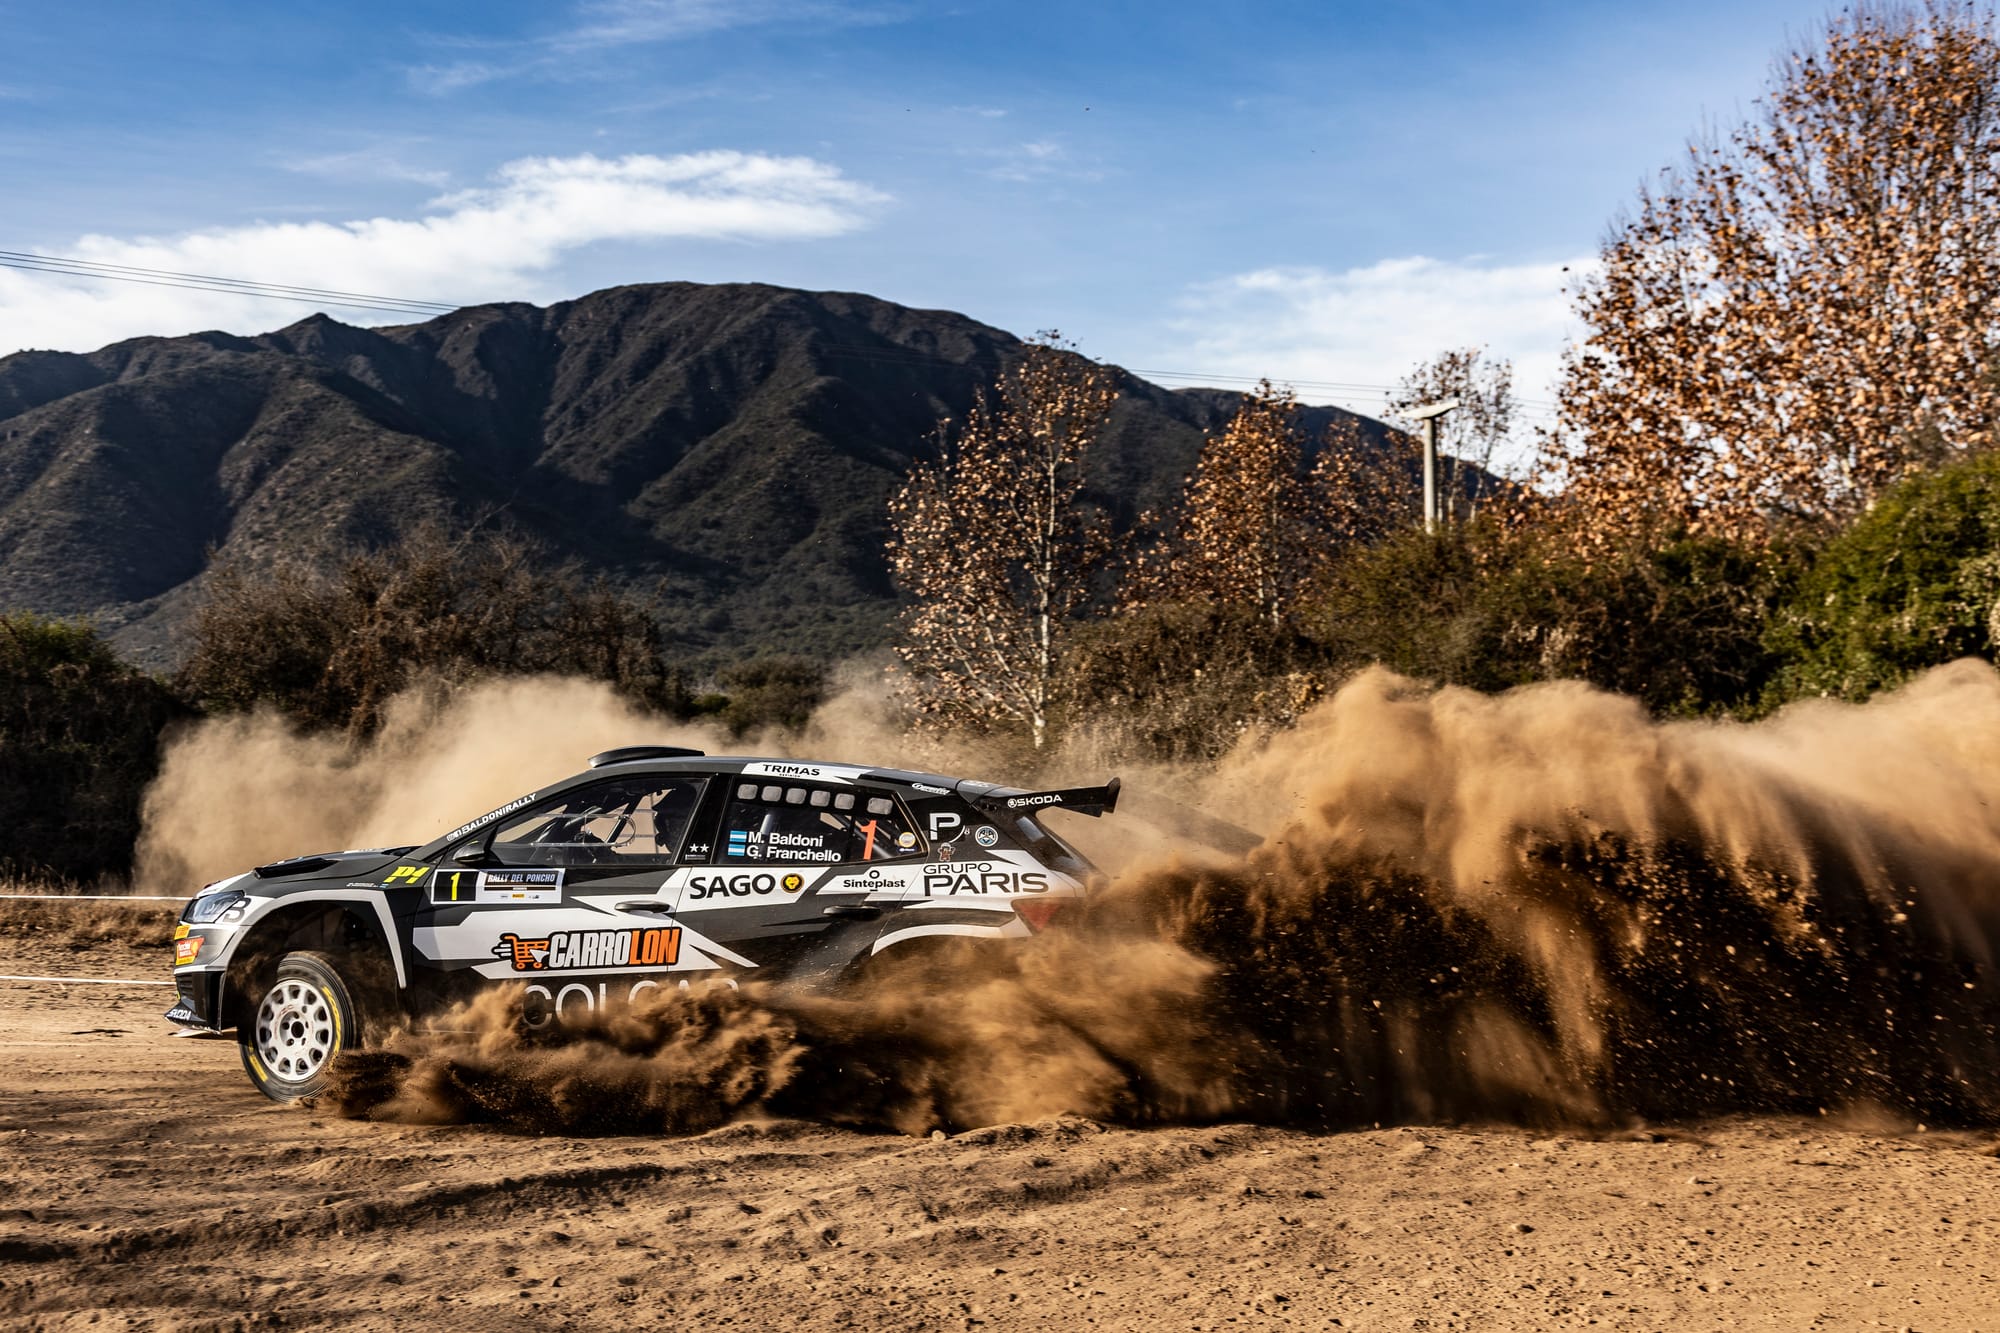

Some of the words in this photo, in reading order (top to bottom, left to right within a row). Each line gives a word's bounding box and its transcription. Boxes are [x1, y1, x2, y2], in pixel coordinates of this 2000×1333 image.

[762, 764, 820, 776] TRIMAS
[1017, 794, 1063, 807] SKODA
[747, 831, 765, 844] M.
[769, 832, 824, 848] Baldoni
[861, 820, 877, 861] 1
[746, 845, 762, 859] G.
[766, 847, 842, 863] Franchello
[923, 862, 993, 875] GRUPO
[487, 874, 509, 883] RALLY
[511, 874, 524, 883] DEL
[526, 873, 556, 883] PONCHO
[689, 873, 776, 900] SAGO
[843, 879, 906, 891] Sinteplast
[924, 873, 1050, 897] PARIS
[450, 872, 460, 902] 1
[550, 928, 681, 968] CARROLON
